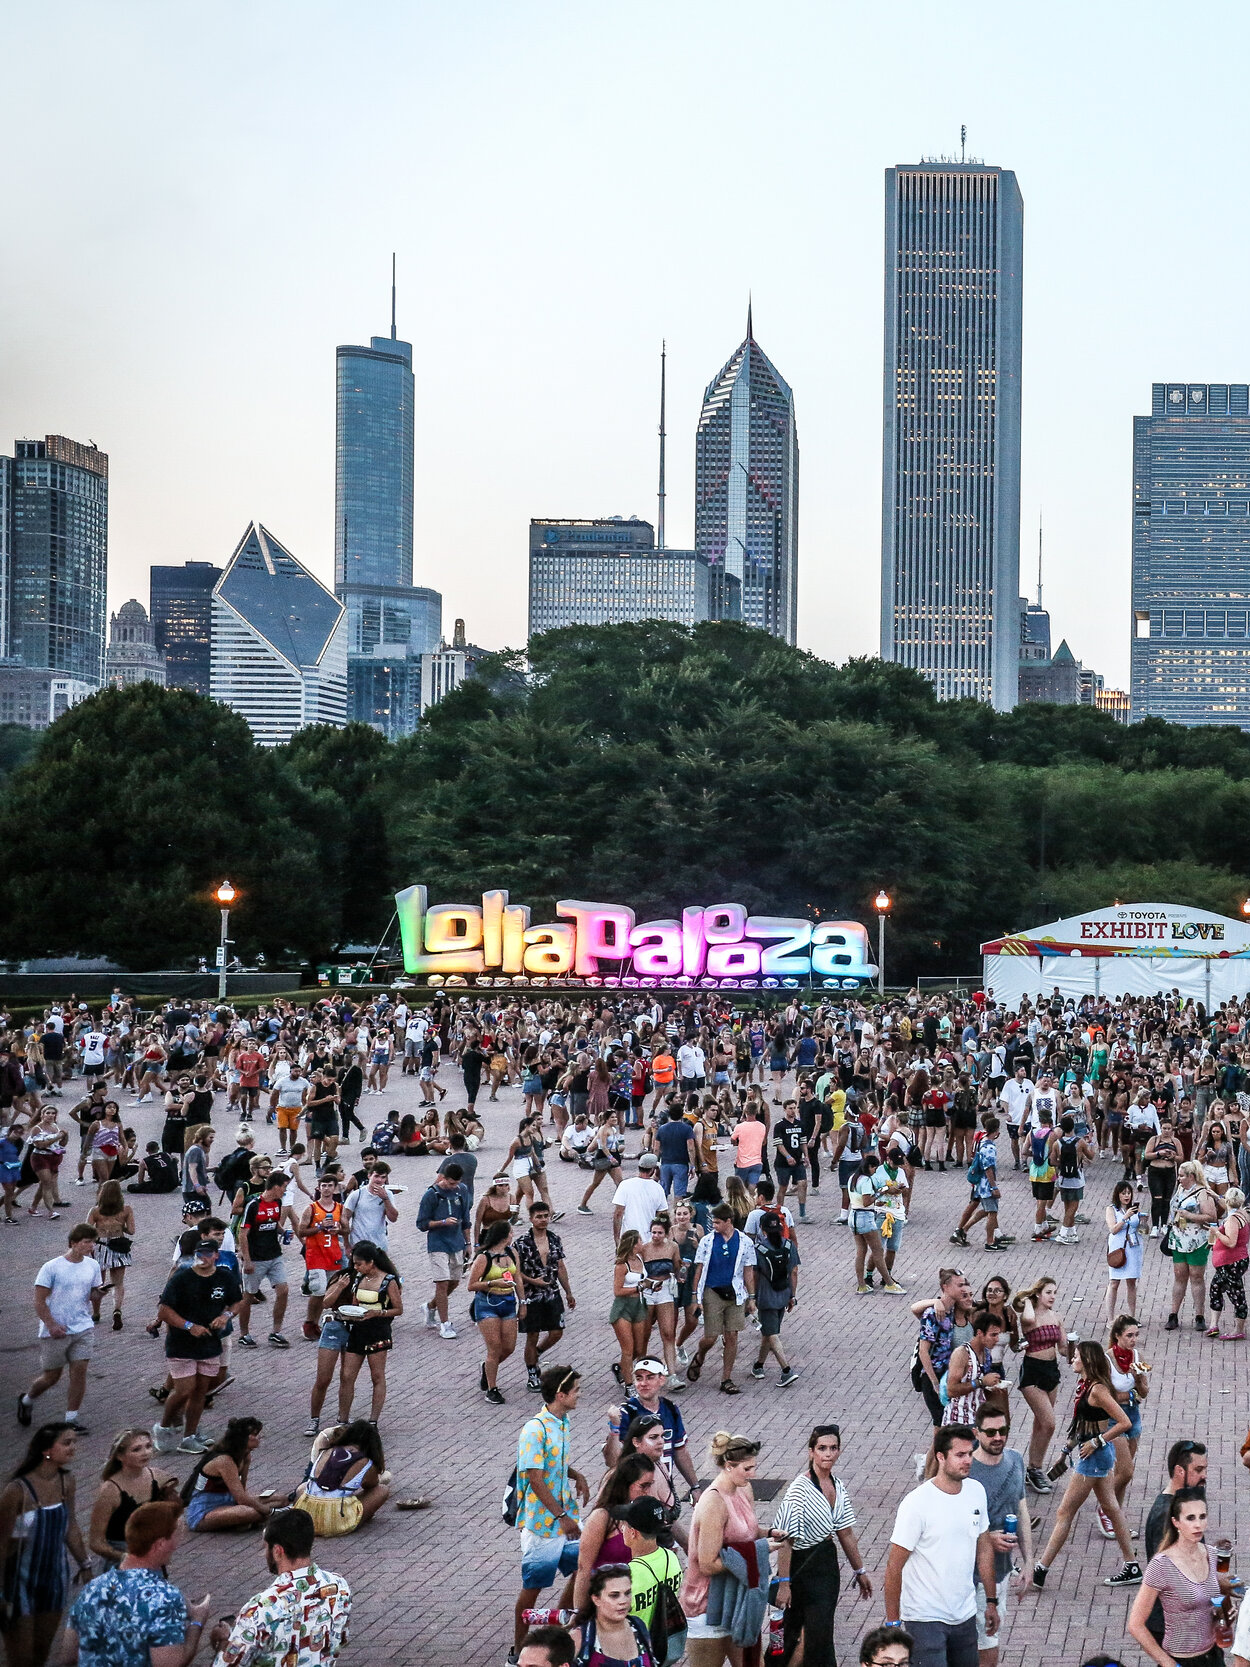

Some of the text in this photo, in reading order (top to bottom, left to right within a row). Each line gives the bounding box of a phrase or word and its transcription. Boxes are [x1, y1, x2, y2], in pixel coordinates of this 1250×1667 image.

[1129, 911, 1167, 920] TOYOTA
[1080, 922, 1225, 940] EXHIBIT LOVE
[88, 1040, 98, 1052] 9
[790, 1133, 800, 1149] 6
[323, 1233, 332, 1248] 3
